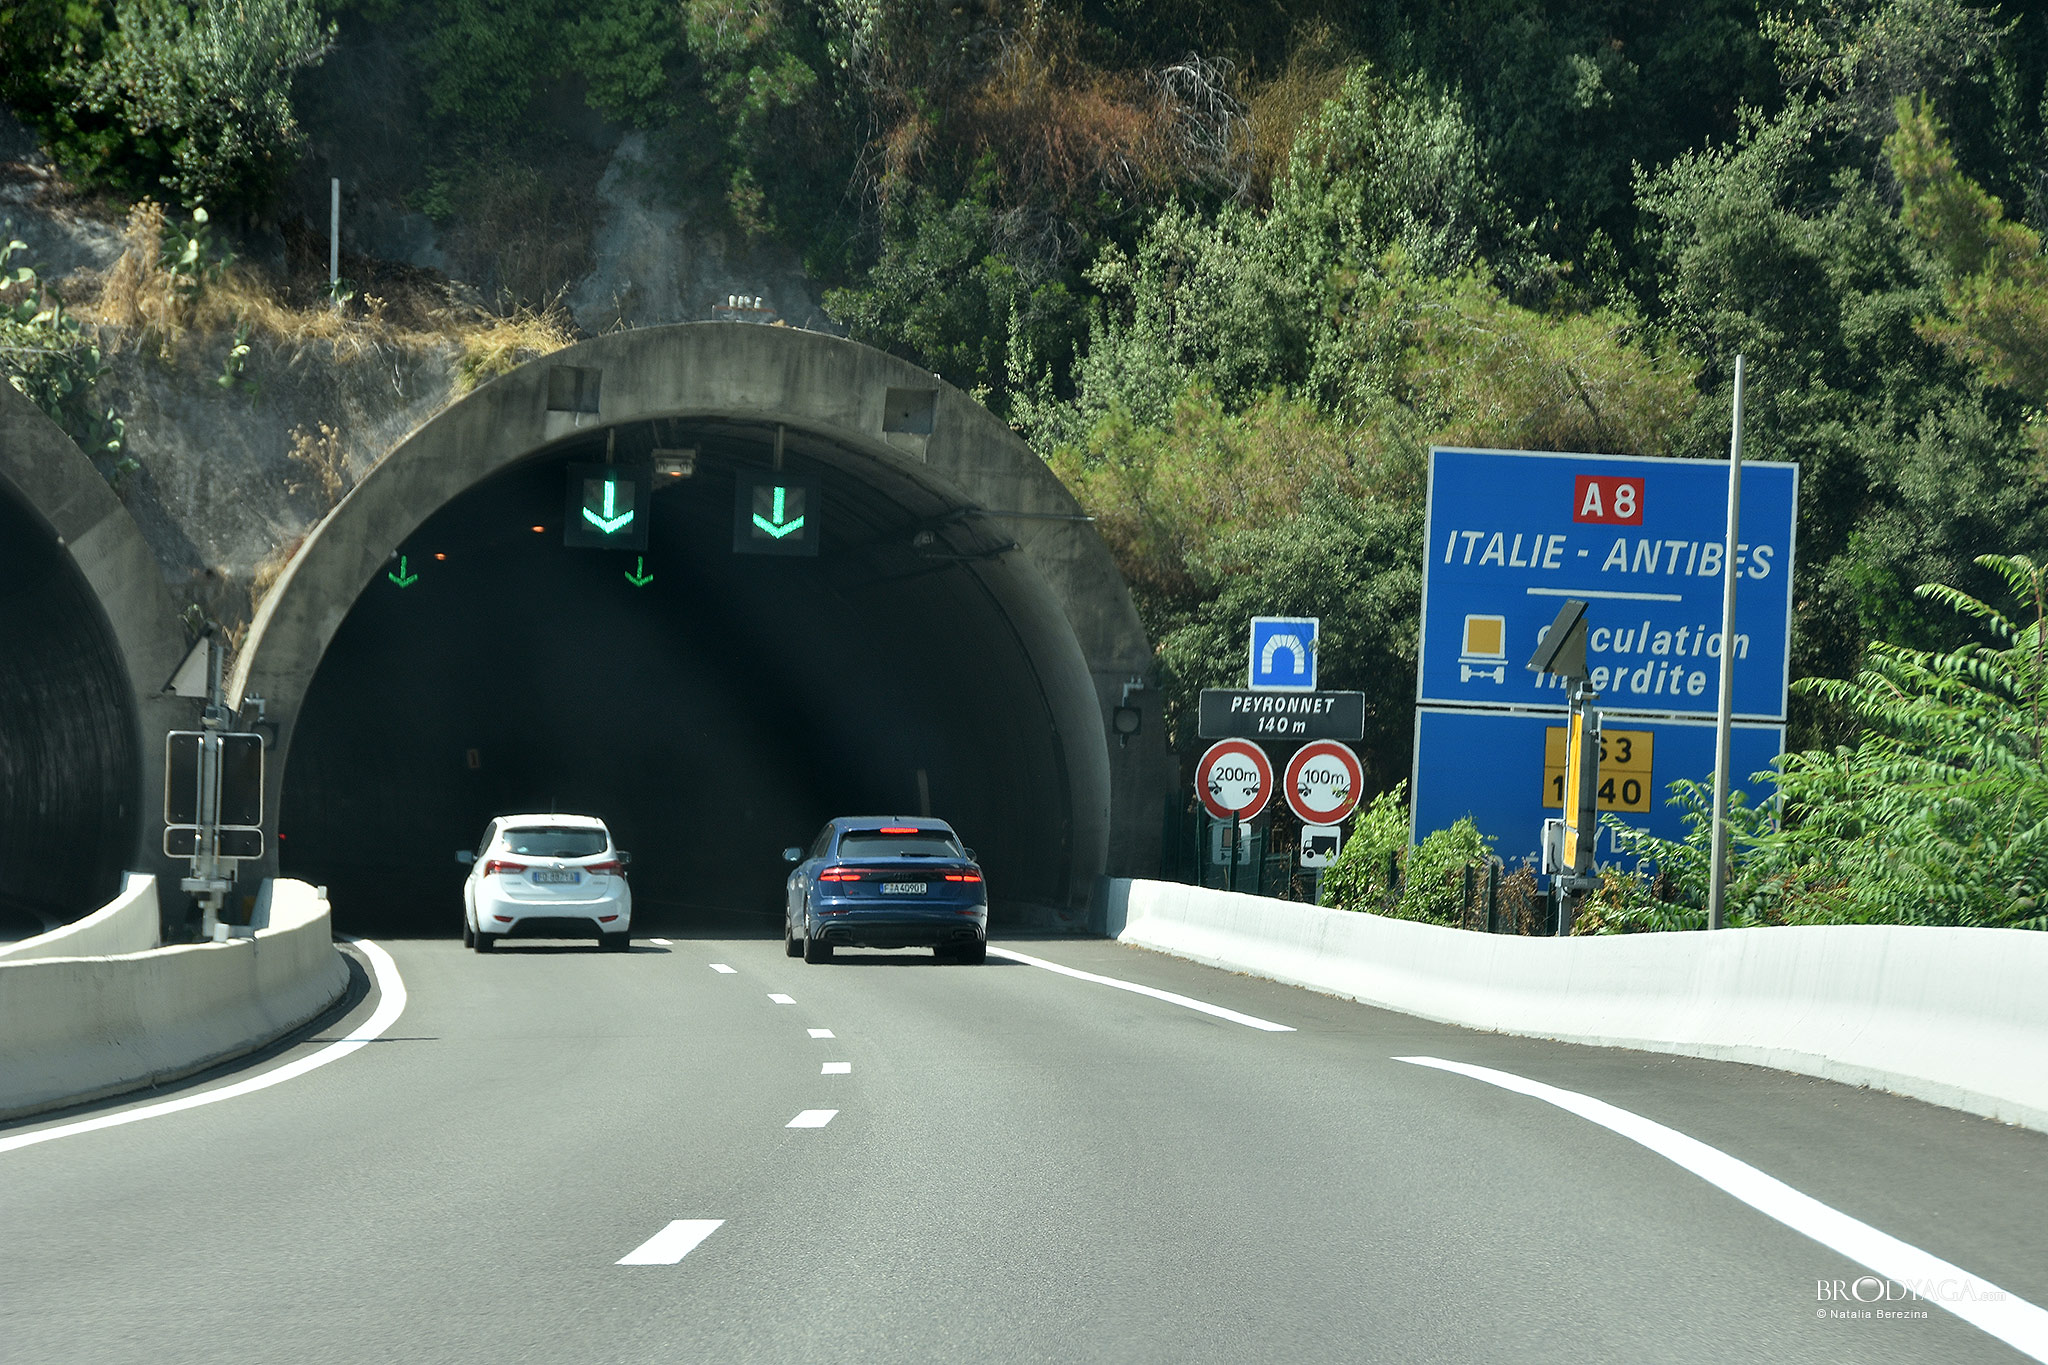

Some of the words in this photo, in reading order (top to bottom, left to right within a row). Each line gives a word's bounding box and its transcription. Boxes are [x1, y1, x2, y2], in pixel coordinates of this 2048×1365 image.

[1444, 530, 1567, 569] ITALIE
[1230, 697, 1335, 714] PEYRONNET
[1257, 716, 1289, 733] 140
[1292, 721, 1307, 734] m
[1215, 767, 1258, 783] 200m
[1303, 769, 1344, 785] 100m
[1552, 775, 1642, 805] 140
